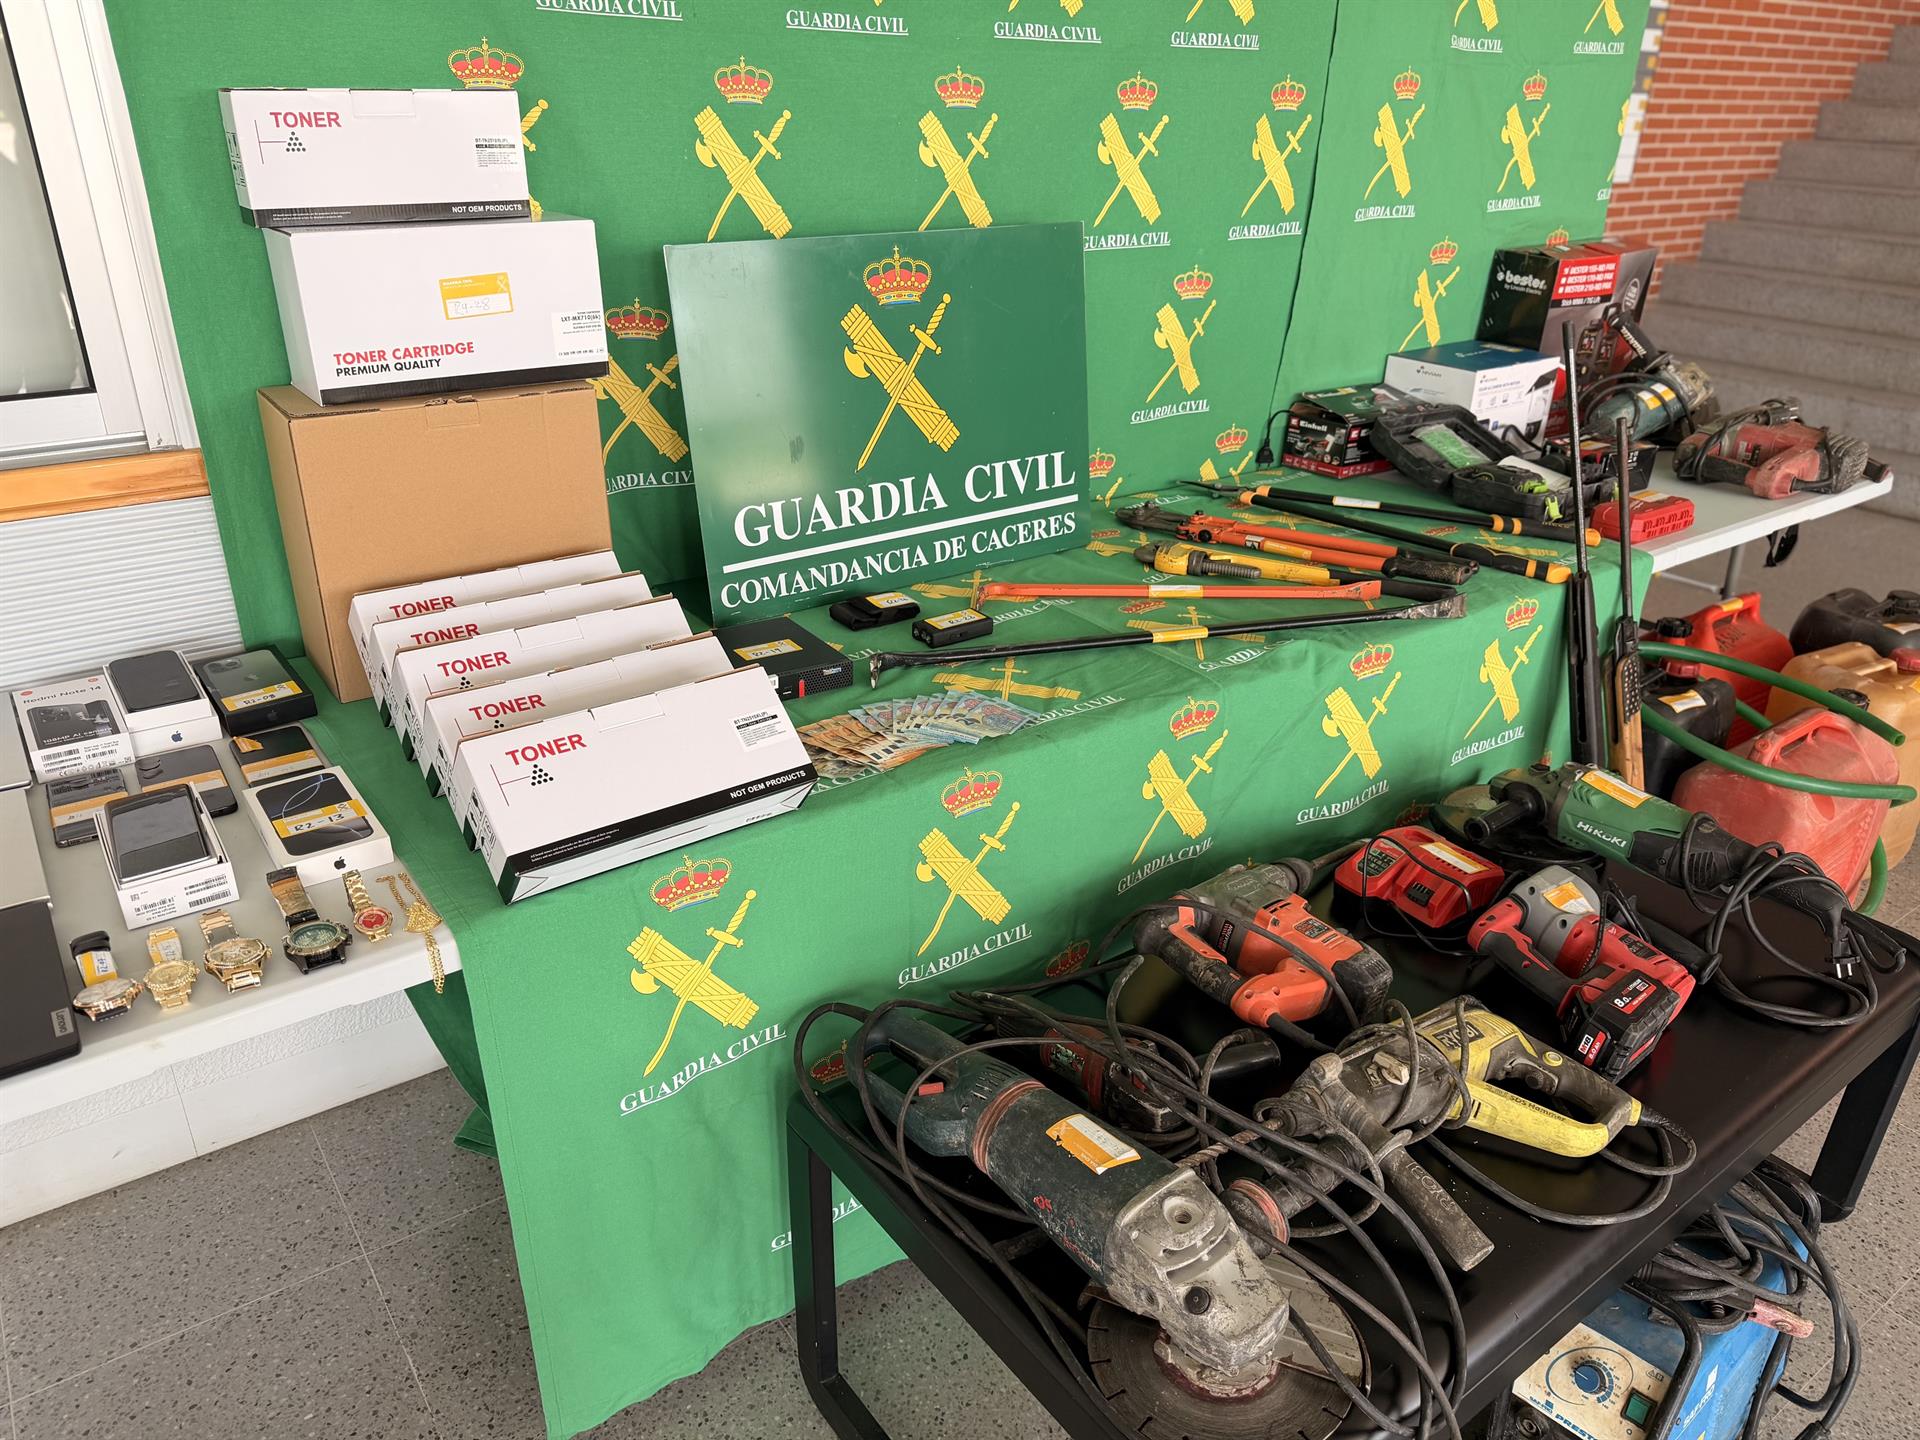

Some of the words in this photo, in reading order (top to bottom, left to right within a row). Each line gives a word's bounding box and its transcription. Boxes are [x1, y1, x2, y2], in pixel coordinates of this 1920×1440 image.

[623, 0, 683, 18] CIVIL
[786, 9, 863, 31] GUARDIA
[865, 15, 908, 34] CIVIL
[994, 20, 1059, 41] GUARDIA
[1061, 26, 1101, 43] CIVIL
[1170, 30, 1231, 48] GUARDIA
[1233, 33, 1260, 50] CIVIL
[1477, 36, 1503, 51] CIVIL
[1573, 41, 1605, 54] GUARDIA
[270, 111, 342, 129] TONER
[452, 205, 467, 214] NOT
[468, 204, 485, 213] OEM
[485, 203, 523, 212] PRODUCTS
[1355, 206, 1392, 221] GUARDIA
[1392, 205, 1416, 218] CIVIL
[1487, 198, 1519, 212] GUARDIA
[1519, 195, 1541, 209] CIVIL
[1140, 231, 1171, 248] CIVIL
[1229, 224, 1275, 240] GUARDIA
[1275, 221, 1302, 237] CIVIL
[1506, 270, 1545, 289] bester
[333, 348, 387, 367] TONER
[394, 341, 475, 362] CARTRIDGE
[335, 363, 391, 378] PREMIUM
[394, 358, 442, 374] QUALITY
[1130, 405, 1171, 424] GUARDIA
[1172, 399, 1210, 416] CIVIL
[1300, 420, 1328, 432] Einhell
[734, 472, 948, 548] GUARDIA
[963, 451, 1076, 503] CIVIL
[720, 541, 928, 610] COMANDANCIA
[933, 531, 968, 564] DE
[970, 511, 1077, 555] CACERES
[389, 595, 457, 619] TONER
[410, 623, 481, 646] TONER
[437, 650, 511, 678] TONER
[60, 689, 86, 697] Note
[1075, 693, 1122, 714] CIVIL
[469, 693, 546, 722] TONER
[506, 733, 587, 767] TONER
[1451, 739, 1492, 764] GUARDIA
[1493, 725, 1525, 748] CIVIL
[729, 786, 746, 799] NOT
[748, 780, 765, 794] OEM
[766, 769, 806, 790] PRODUCTS
[1296, 799, 1349, 825] GUARDIA
[1349, 780, 1390, 810] CIVIL
[1118, 856, 1175, 893] GUARDIA
[1176, 836, 1214, 862] CIVIL
[898, 944, 982, 987] GUARDIA
[983, 923, 1032, 950] CIVIL
[1579, 1035, 1594, 1055] M18
[620, 1049, 725, 1114] GUARDIA
[726, 1024, 787, 1059] CIVIL
[1509, 1095, 1527, 1108] SDS
[1527, 1101, 1567, 1123] Hammer
